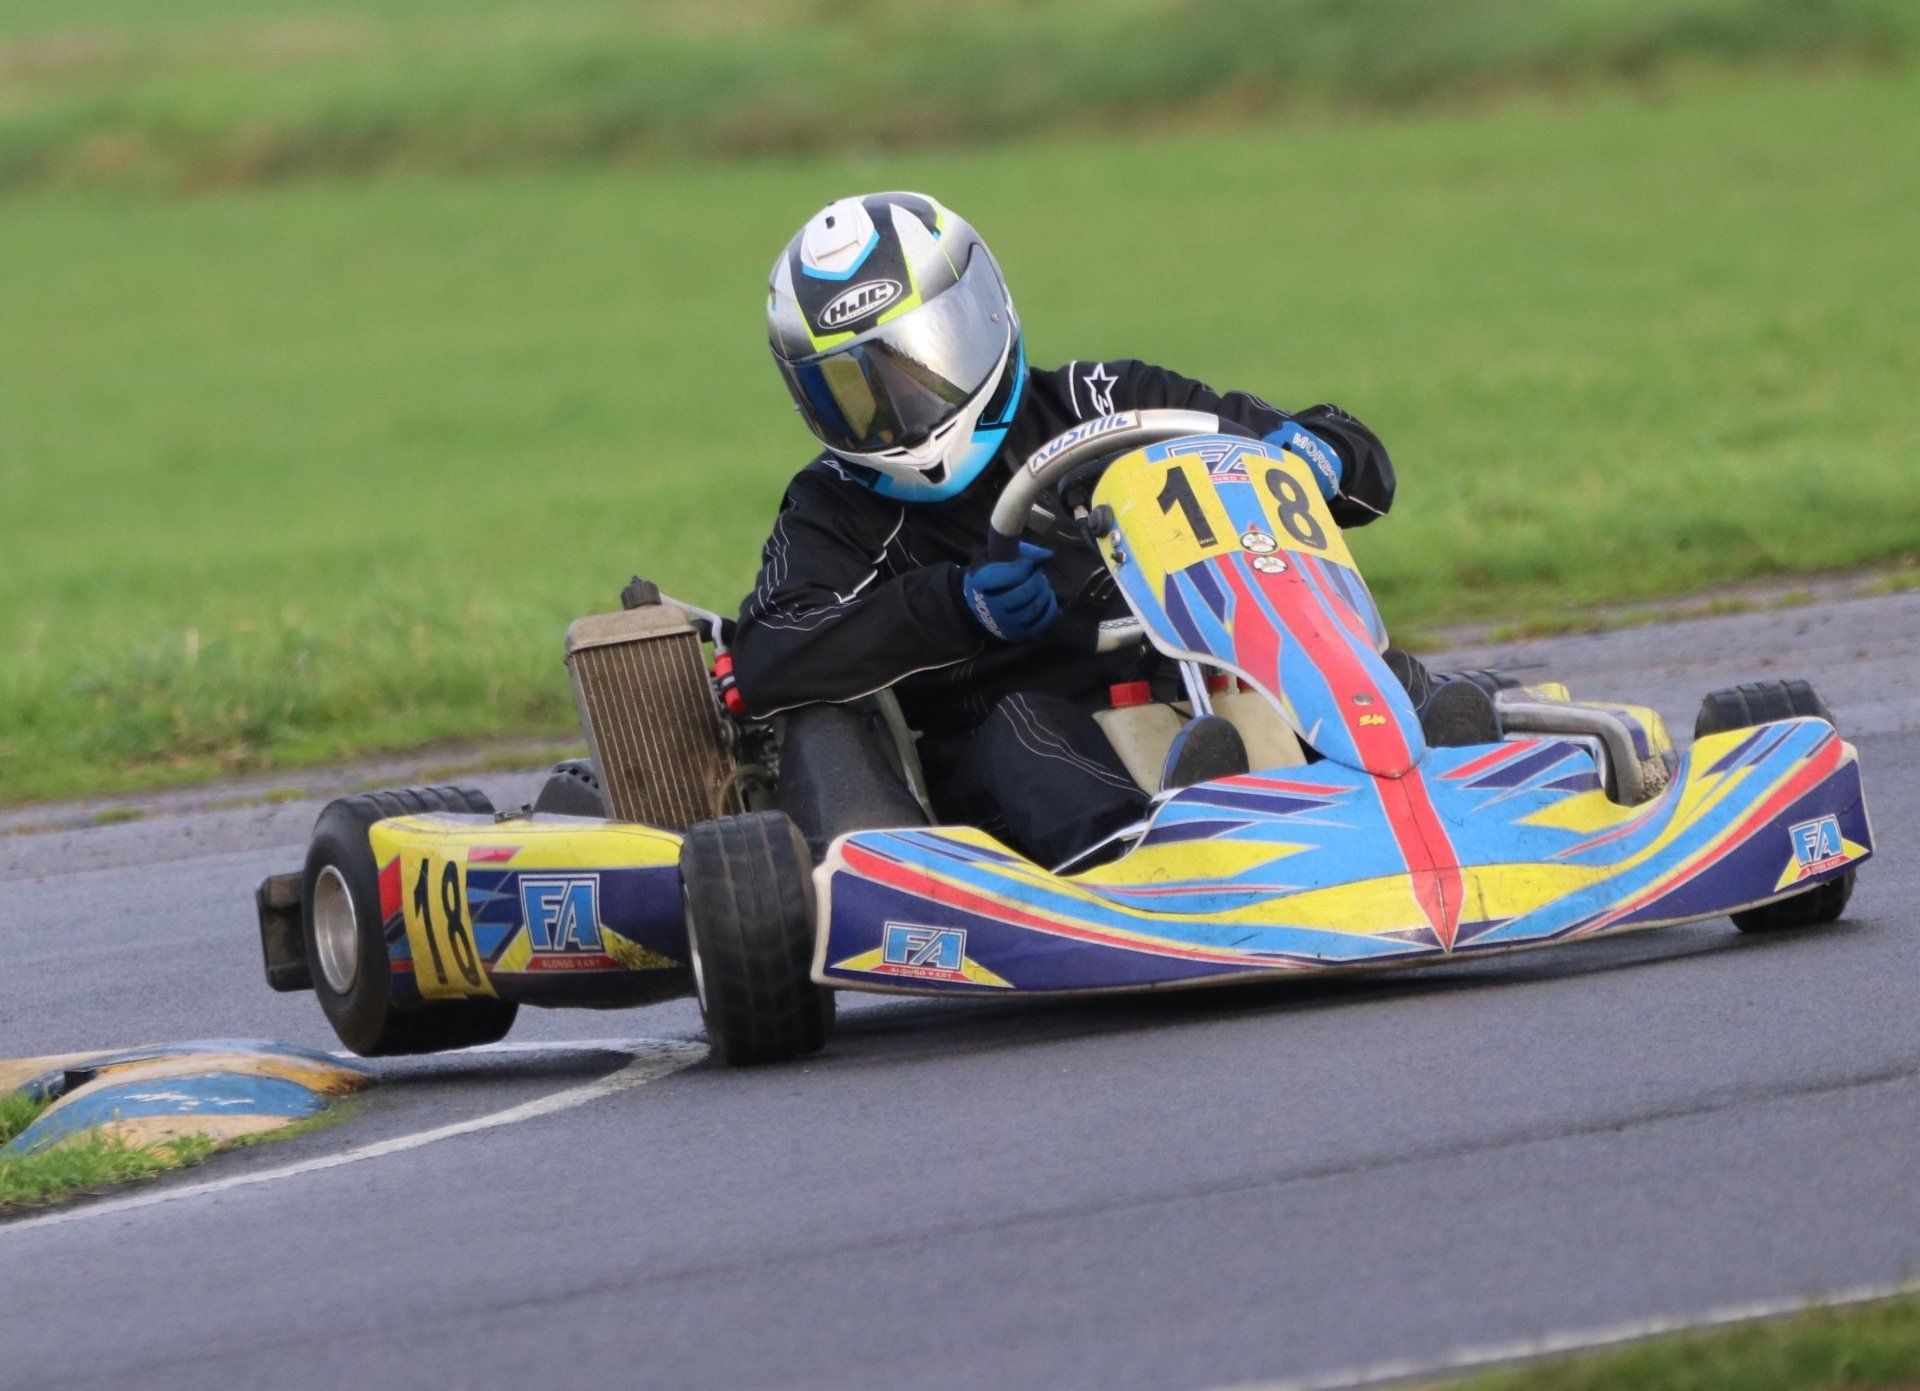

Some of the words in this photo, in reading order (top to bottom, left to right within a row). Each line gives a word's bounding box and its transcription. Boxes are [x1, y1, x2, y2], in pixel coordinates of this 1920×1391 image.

[829, 283, 888, 323] HJC
[1157, 466, 1218, 549] 1
[1265, 468, 1327, 549] 8
[1789, 814, 1843, 866] FA
[414, 858, 482, 986] 18
[520, 875, 605, 952] FA
[884, 922, 966, 971] FA
